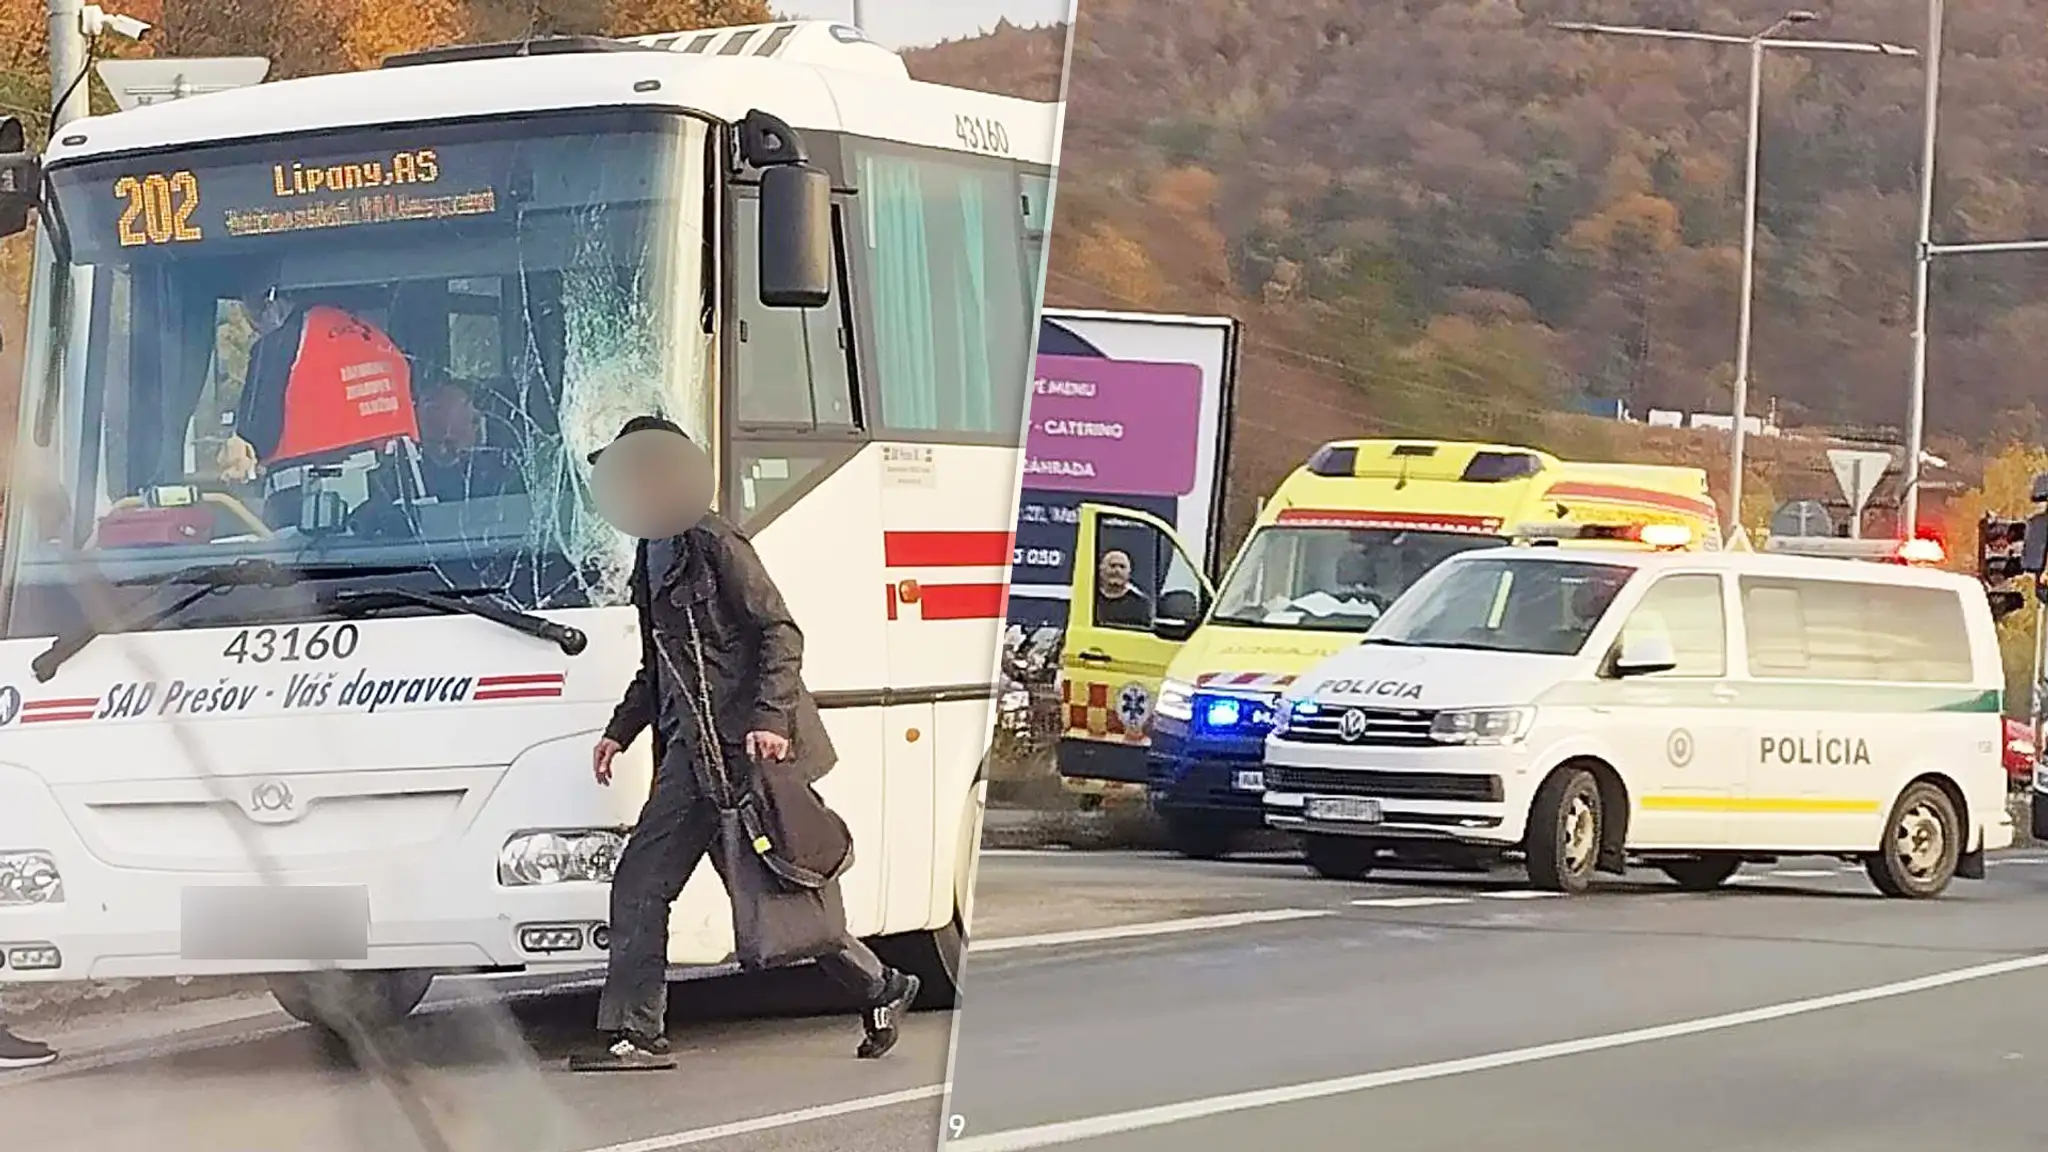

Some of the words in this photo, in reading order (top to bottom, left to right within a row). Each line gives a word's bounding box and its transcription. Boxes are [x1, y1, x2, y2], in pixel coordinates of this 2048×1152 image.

[955, 114, 1009, 154] 43160
[114, 170, 202, 247] 202
[223, 624, 359, 664] 43160
[98, 681, 157, 719] SAD
[158, 677, 259, 716] Prešov
[283, 672, 337, 709] Váš
[337, 668, 473, 713] dopravca
[1760, 731, 1870, 765] POLÍCIA
